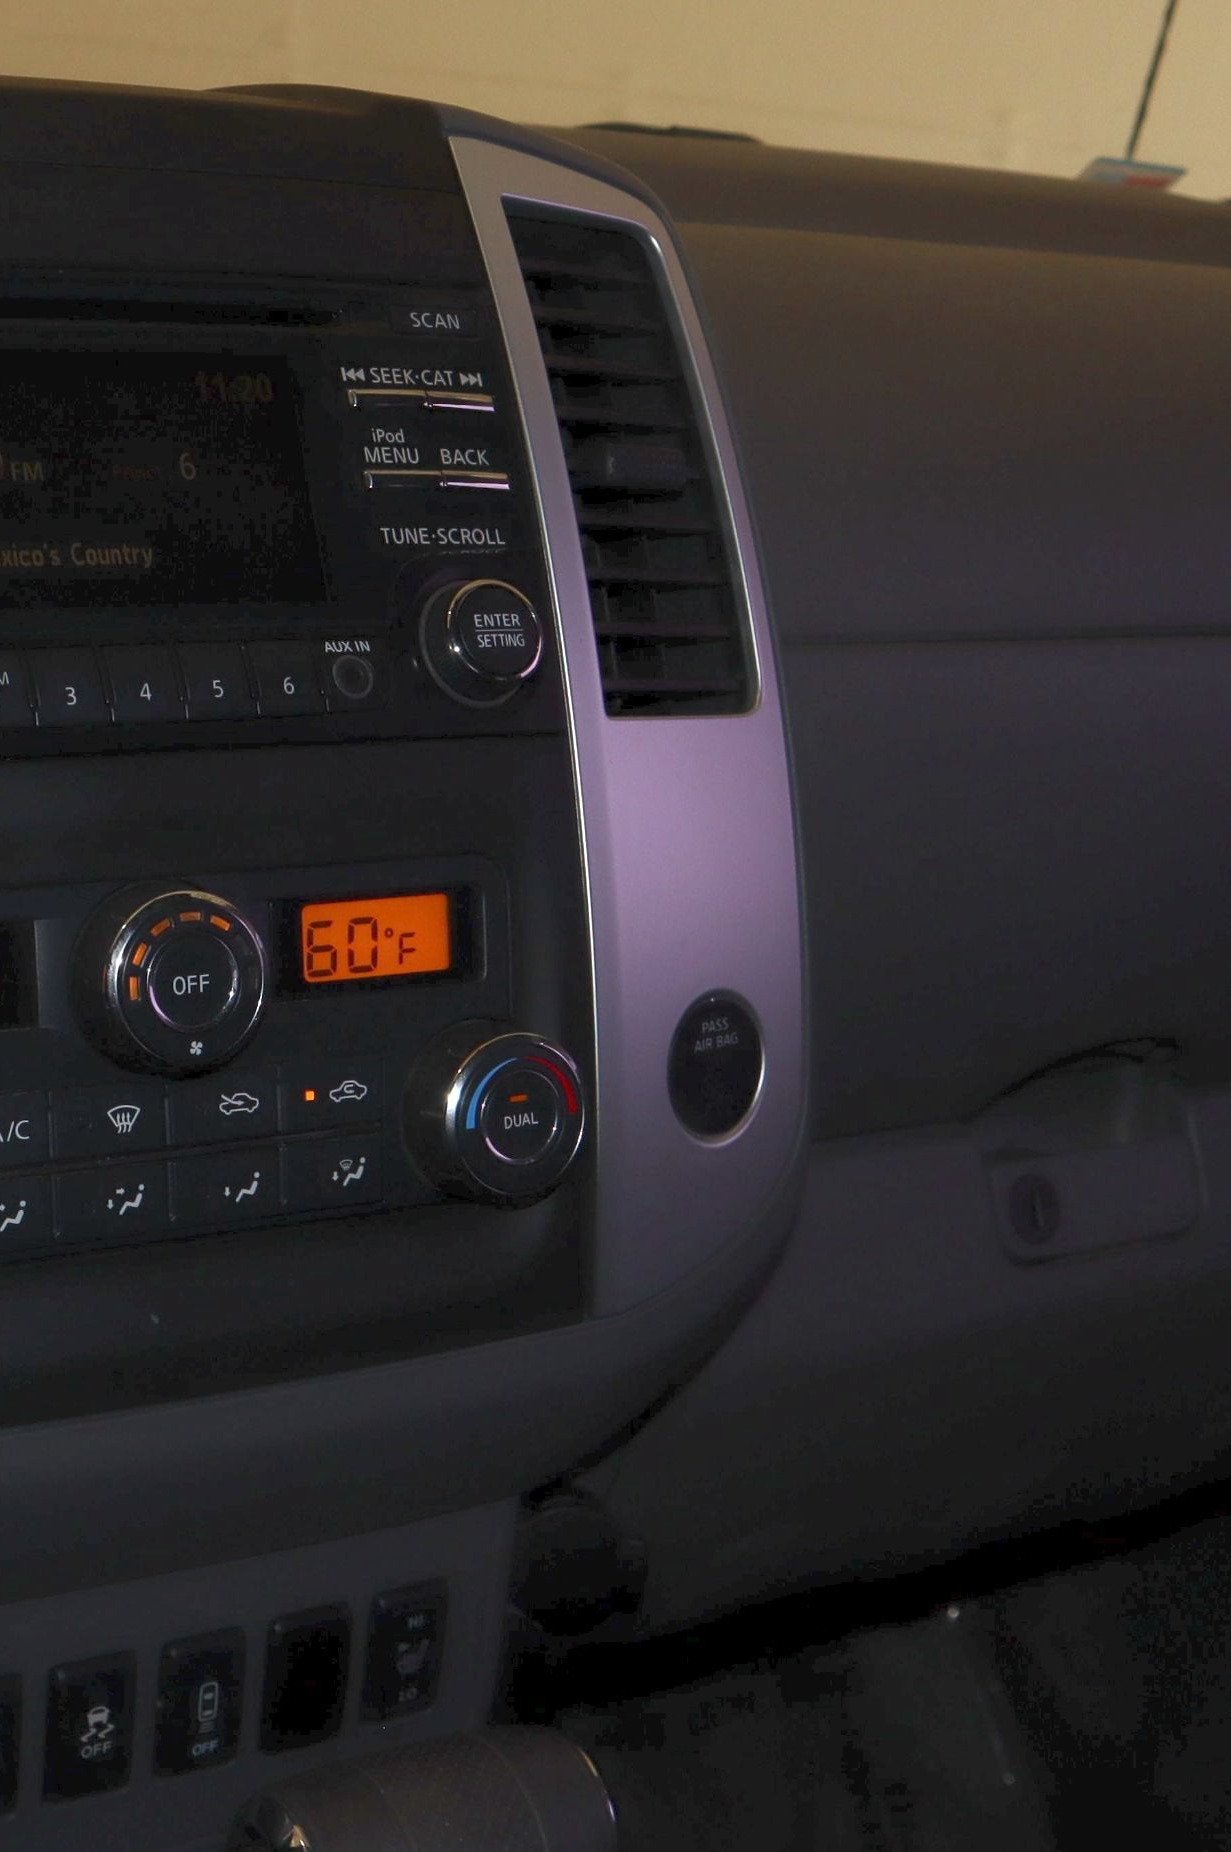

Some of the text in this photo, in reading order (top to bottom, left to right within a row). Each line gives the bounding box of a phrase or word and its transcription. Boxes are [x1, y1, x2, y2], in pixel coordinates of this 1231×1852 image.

[409, 311, 461, 330] SCAN
[371, 427, 406, 444] iPod
[364, 446, 419, 464] MENU
[440, 448, 490, 466] BACK
[179, 451, 197, 481] 6
[70, 542, 154, 569] Country
[474, 612, 521, 628] ENTER
[324, 640, 371, 653] AUX IN
[477, 633, 525, 648] SETTING
[139, 682, 153, 702] 4
[212, 679, 224, 699] 5
[283, 676, 295, 695] 6
[64, 686, 78, 706] 3
[172, 973, 211, 996] OFF
[701, 1017, 730, 1034] PASS
[693, 1030, 739, 1053] AIR BAG
[503, 1111, 540, 1130] DUAL
[80, 1740, 113, 1760] OFF
[191, 1739, 219, 1757] OFF
